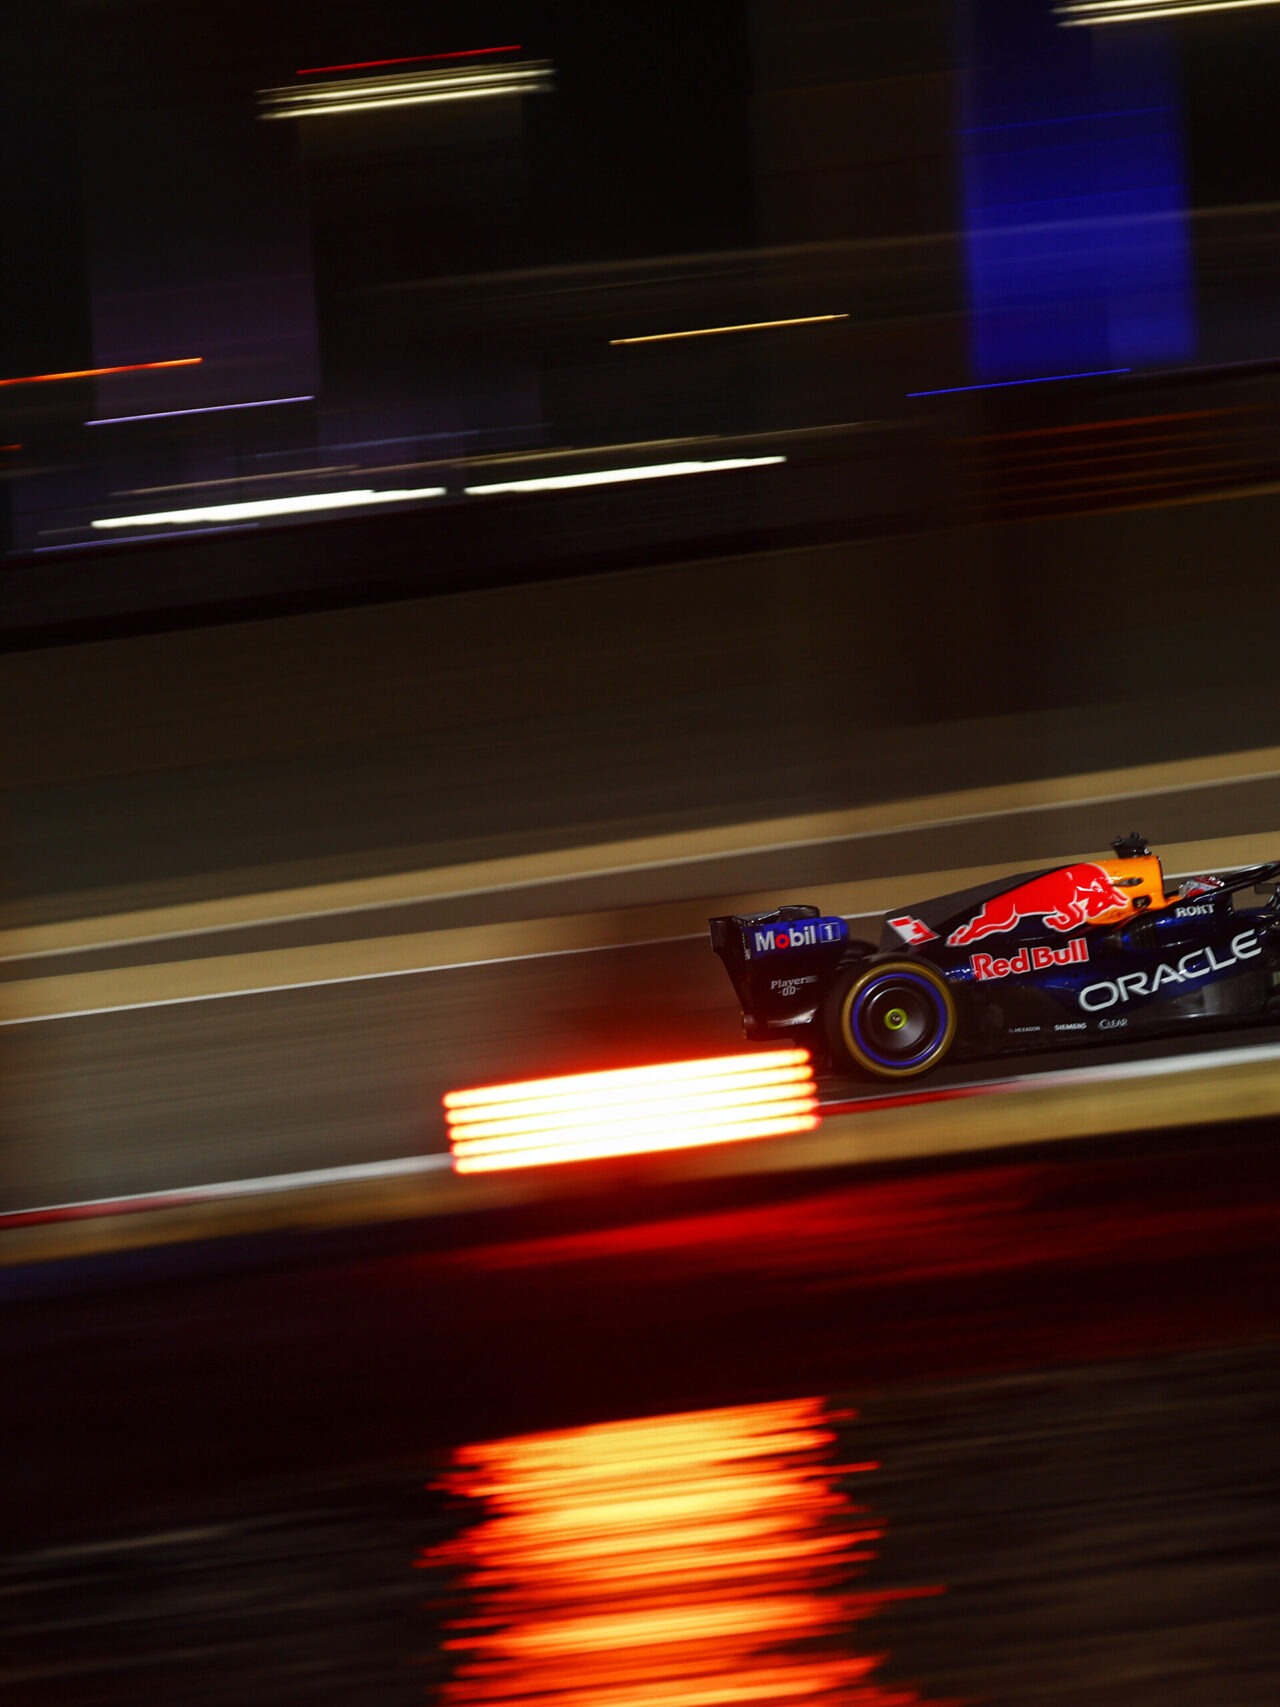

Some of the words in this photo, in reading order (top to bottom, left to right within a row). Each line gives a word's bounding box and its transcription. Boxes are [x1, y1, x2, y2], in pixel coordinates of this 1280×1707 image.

[1175, 903, 1216, 918] ROKT
[754, 925, 817, 952] Mobil
[970, 947, 1031, 983] Red
[1030, 936, 1090, 971] Bull
[1078, 928, 1263, 1012] ORACLE
[1053, 1022, 1087, 1032] SIEMENS
